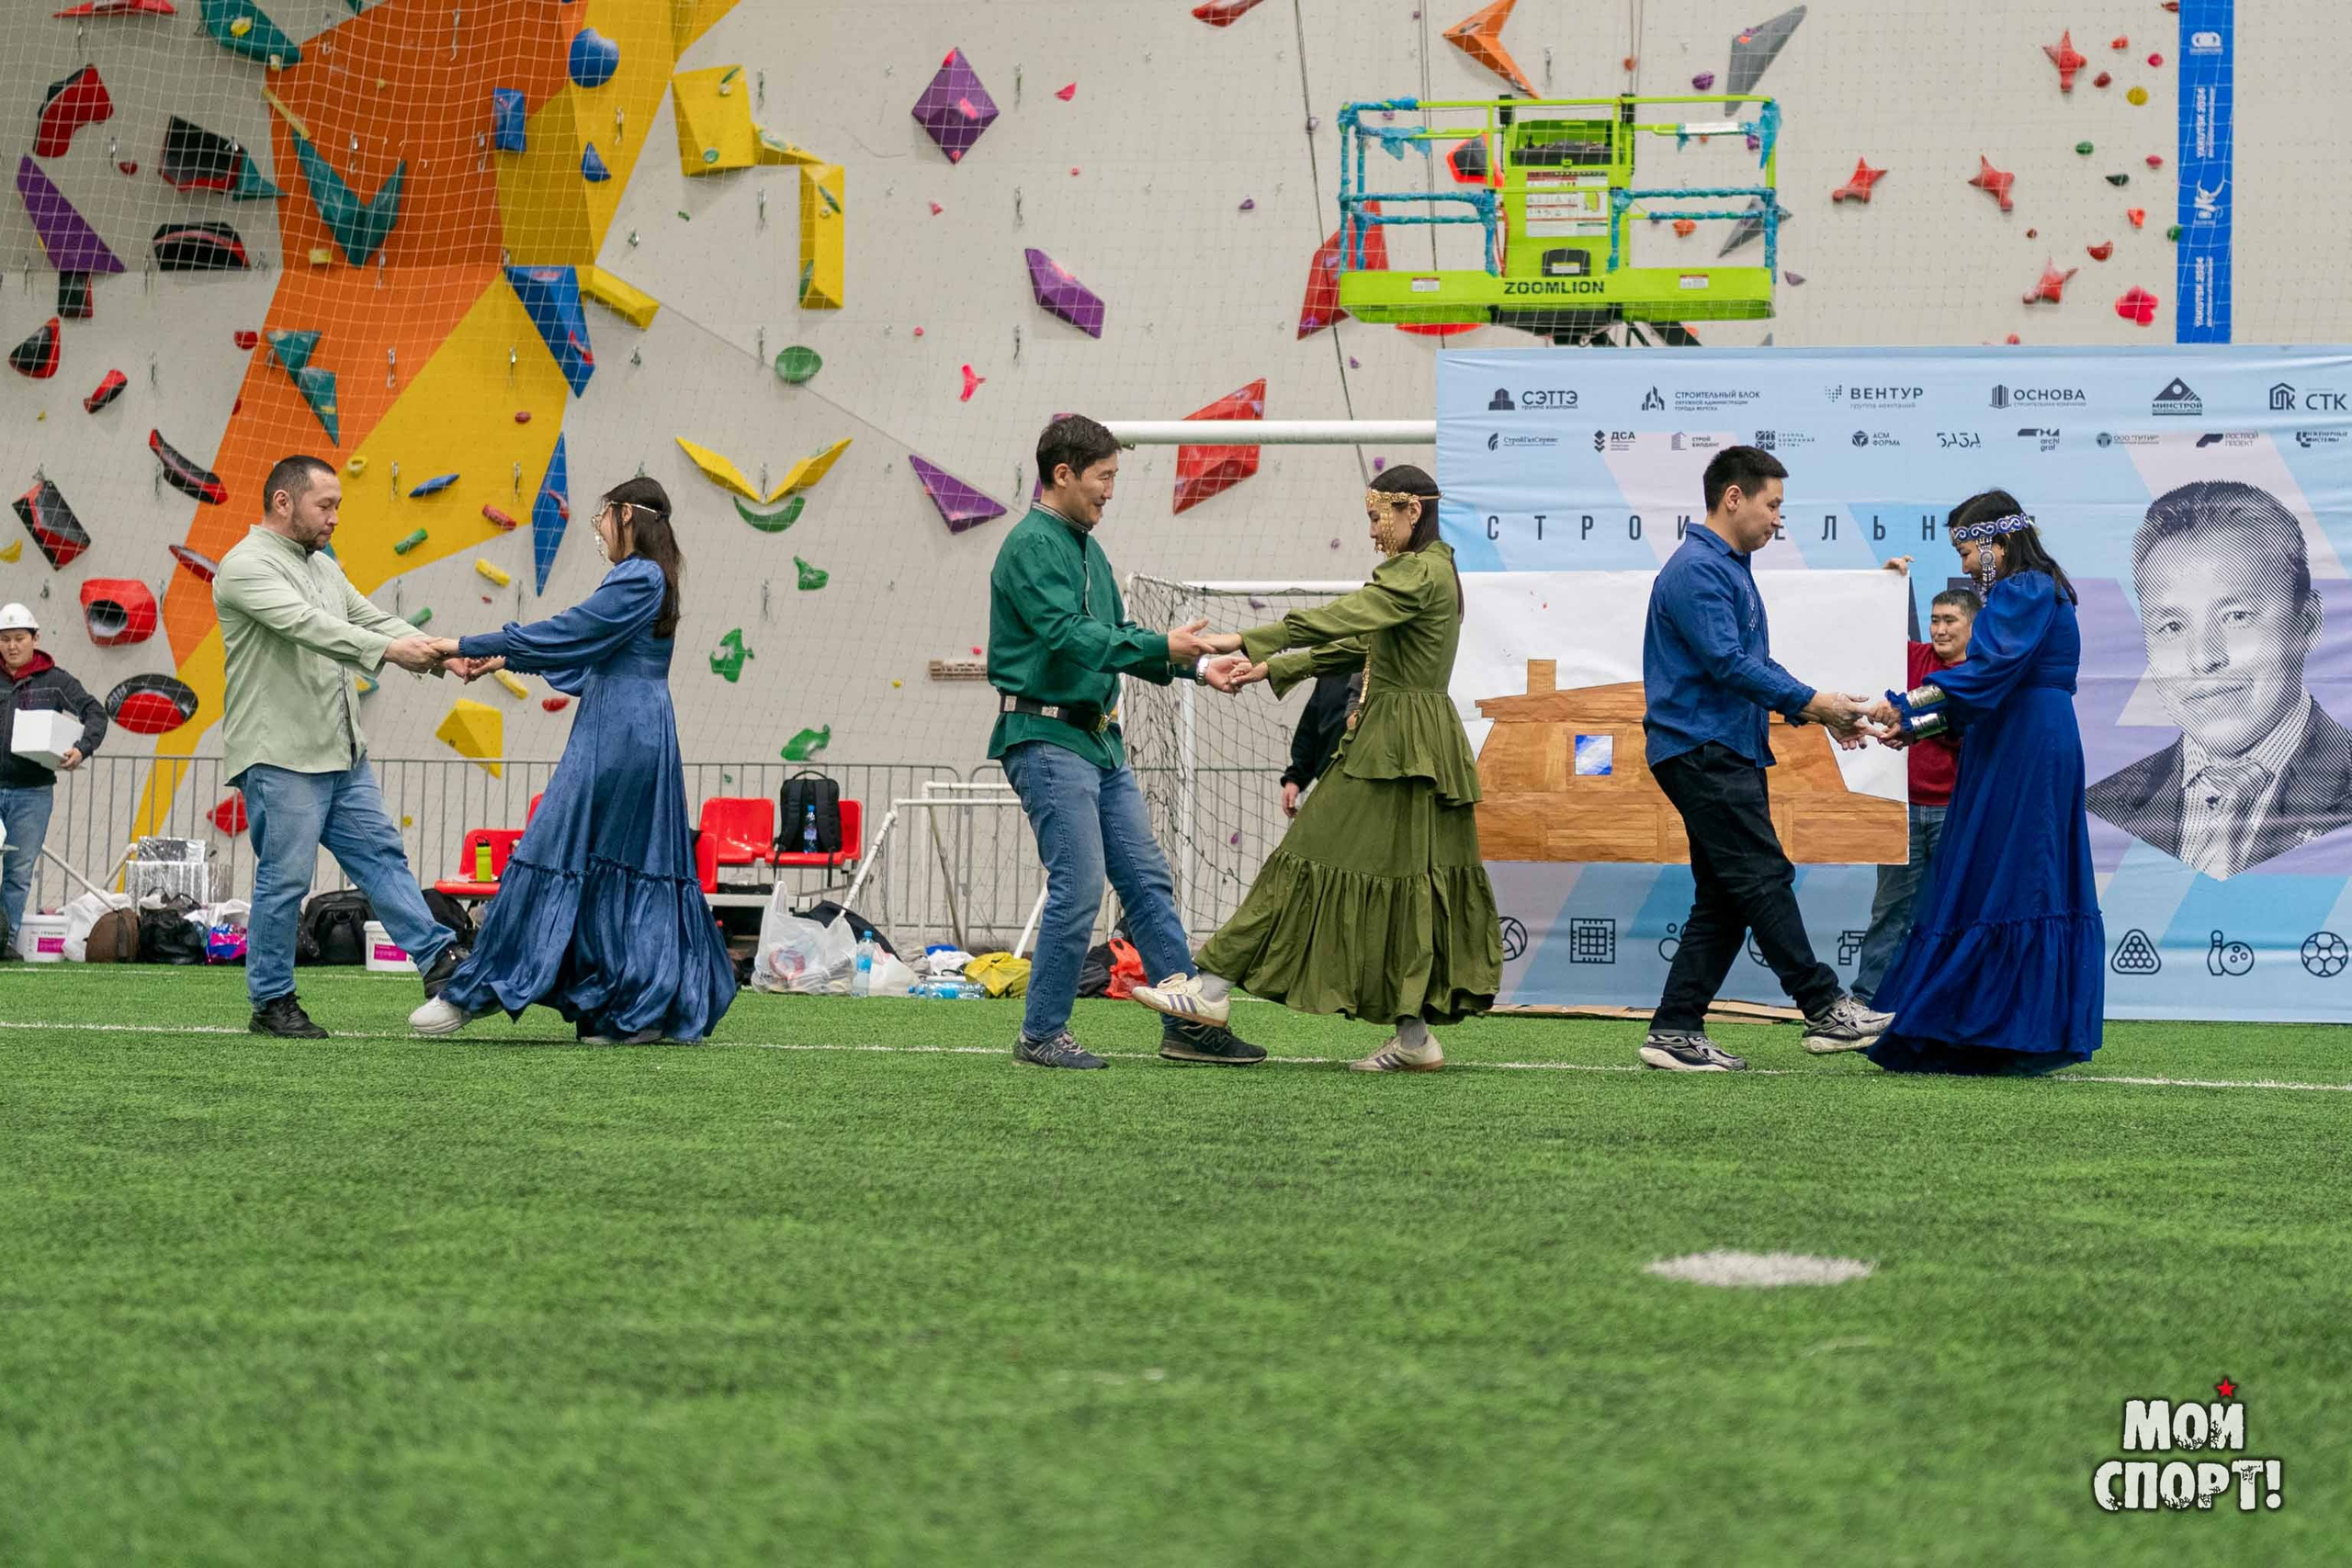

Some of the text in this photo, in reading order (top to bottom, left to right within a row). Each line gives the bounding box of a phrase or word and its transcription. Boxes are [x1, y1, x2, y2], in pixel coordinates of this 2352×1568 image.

[1504, 281, 1604, 295] ZOOMLION
[1521, 390, 1578, 405] СЭТТЭ
[1675, 390, 1736, 399] СТРОИТЕЛЬНЫЙ
[1850, 388, 1924, 400] ВЕНТУР
[2013, 389, 2086, 400] ОСНОВА
[2305, 393, 2347, 411] СТК
[1611, 431, 1636, 441] ДСА
